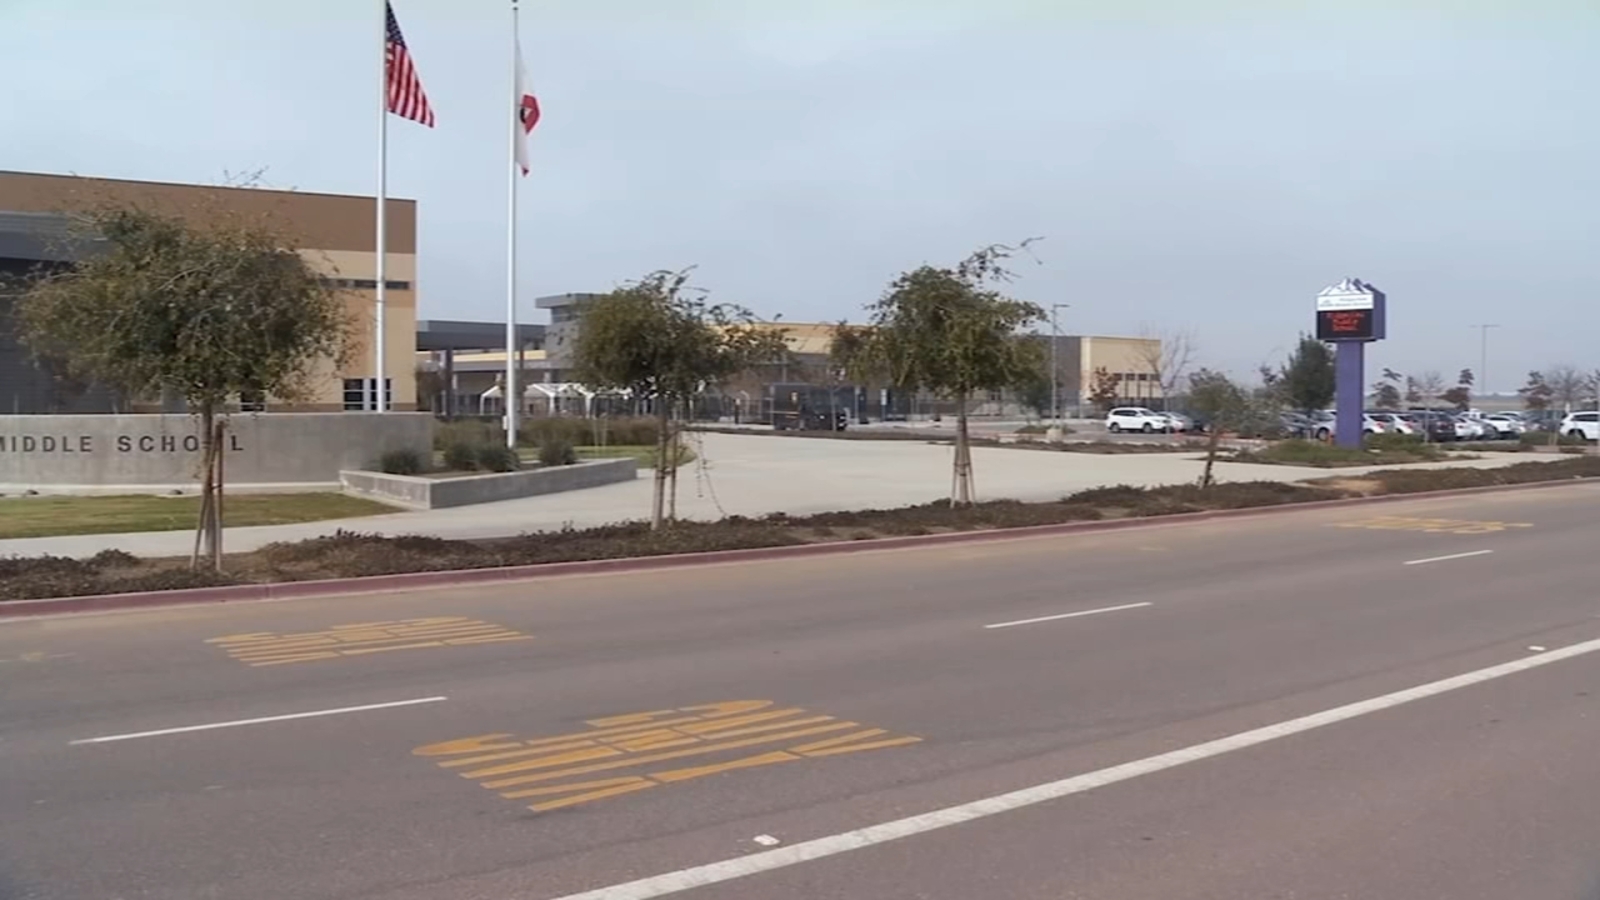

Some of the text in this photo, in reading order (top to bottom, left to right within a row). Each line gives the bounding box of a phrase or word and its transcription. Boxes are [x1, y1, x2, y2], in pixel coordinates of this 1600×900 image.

[117, 434, 245, 453] SCHOL
[203, 616, 534, 667] XING
[411, 699, 924, 813] XING
